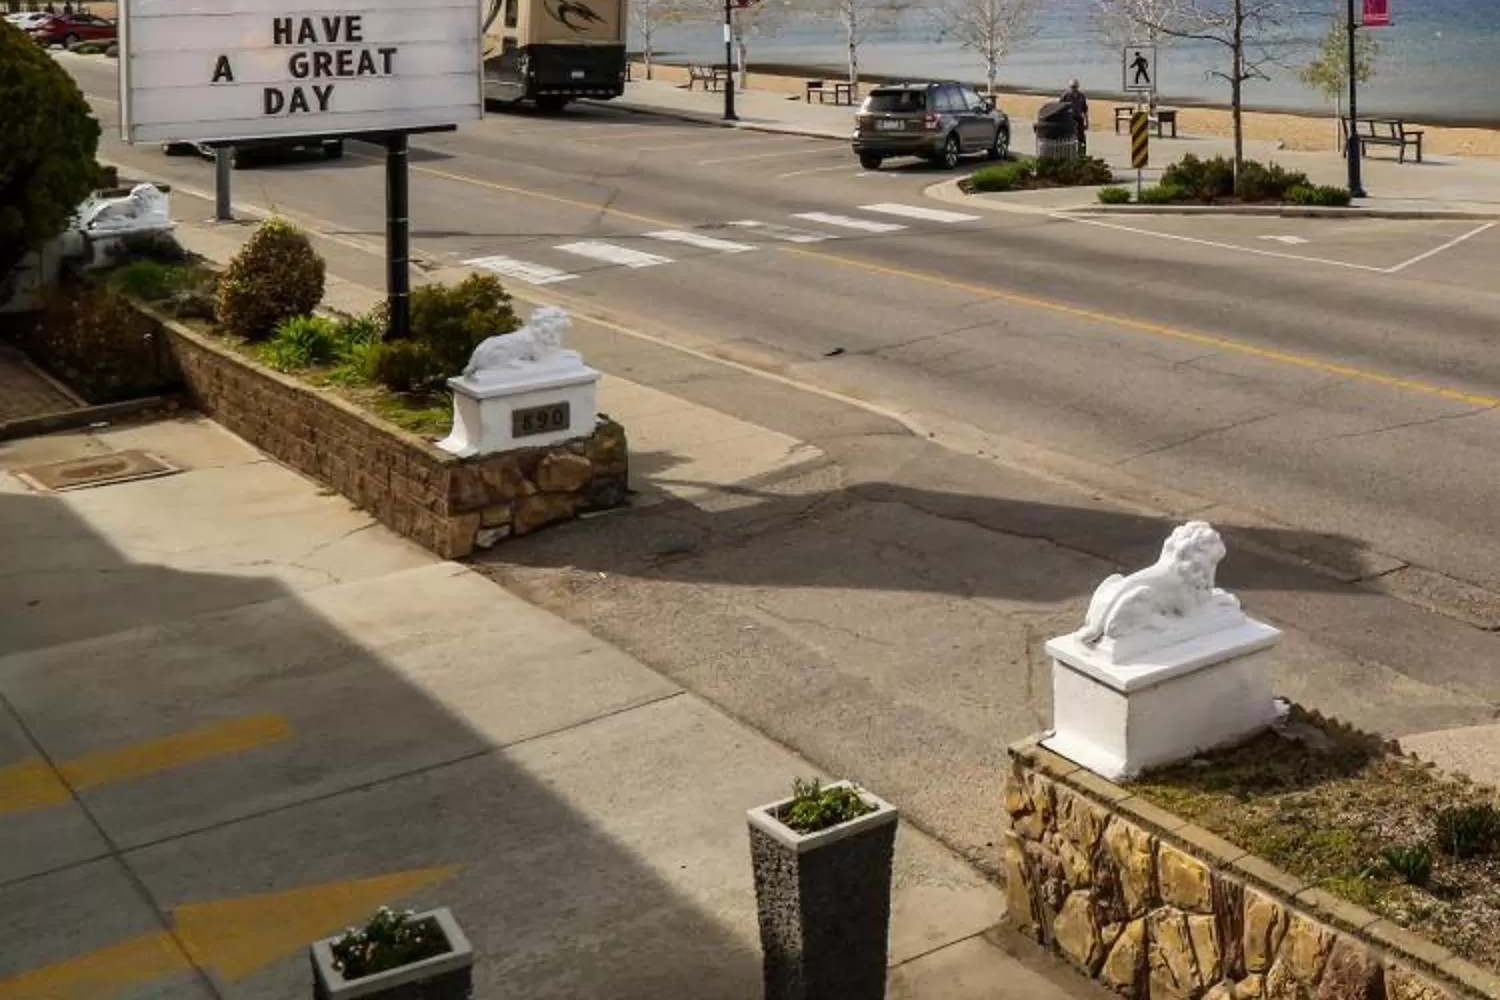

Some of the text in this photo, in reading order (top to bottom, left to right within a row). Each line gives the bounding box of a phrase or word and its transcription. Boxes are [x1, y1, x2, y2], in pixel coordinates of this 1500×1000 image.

[273, 16, 363, 45] HAVE
[212, 48, 397, 82] A GREAT
[264, 85, 335, 115] DAY
